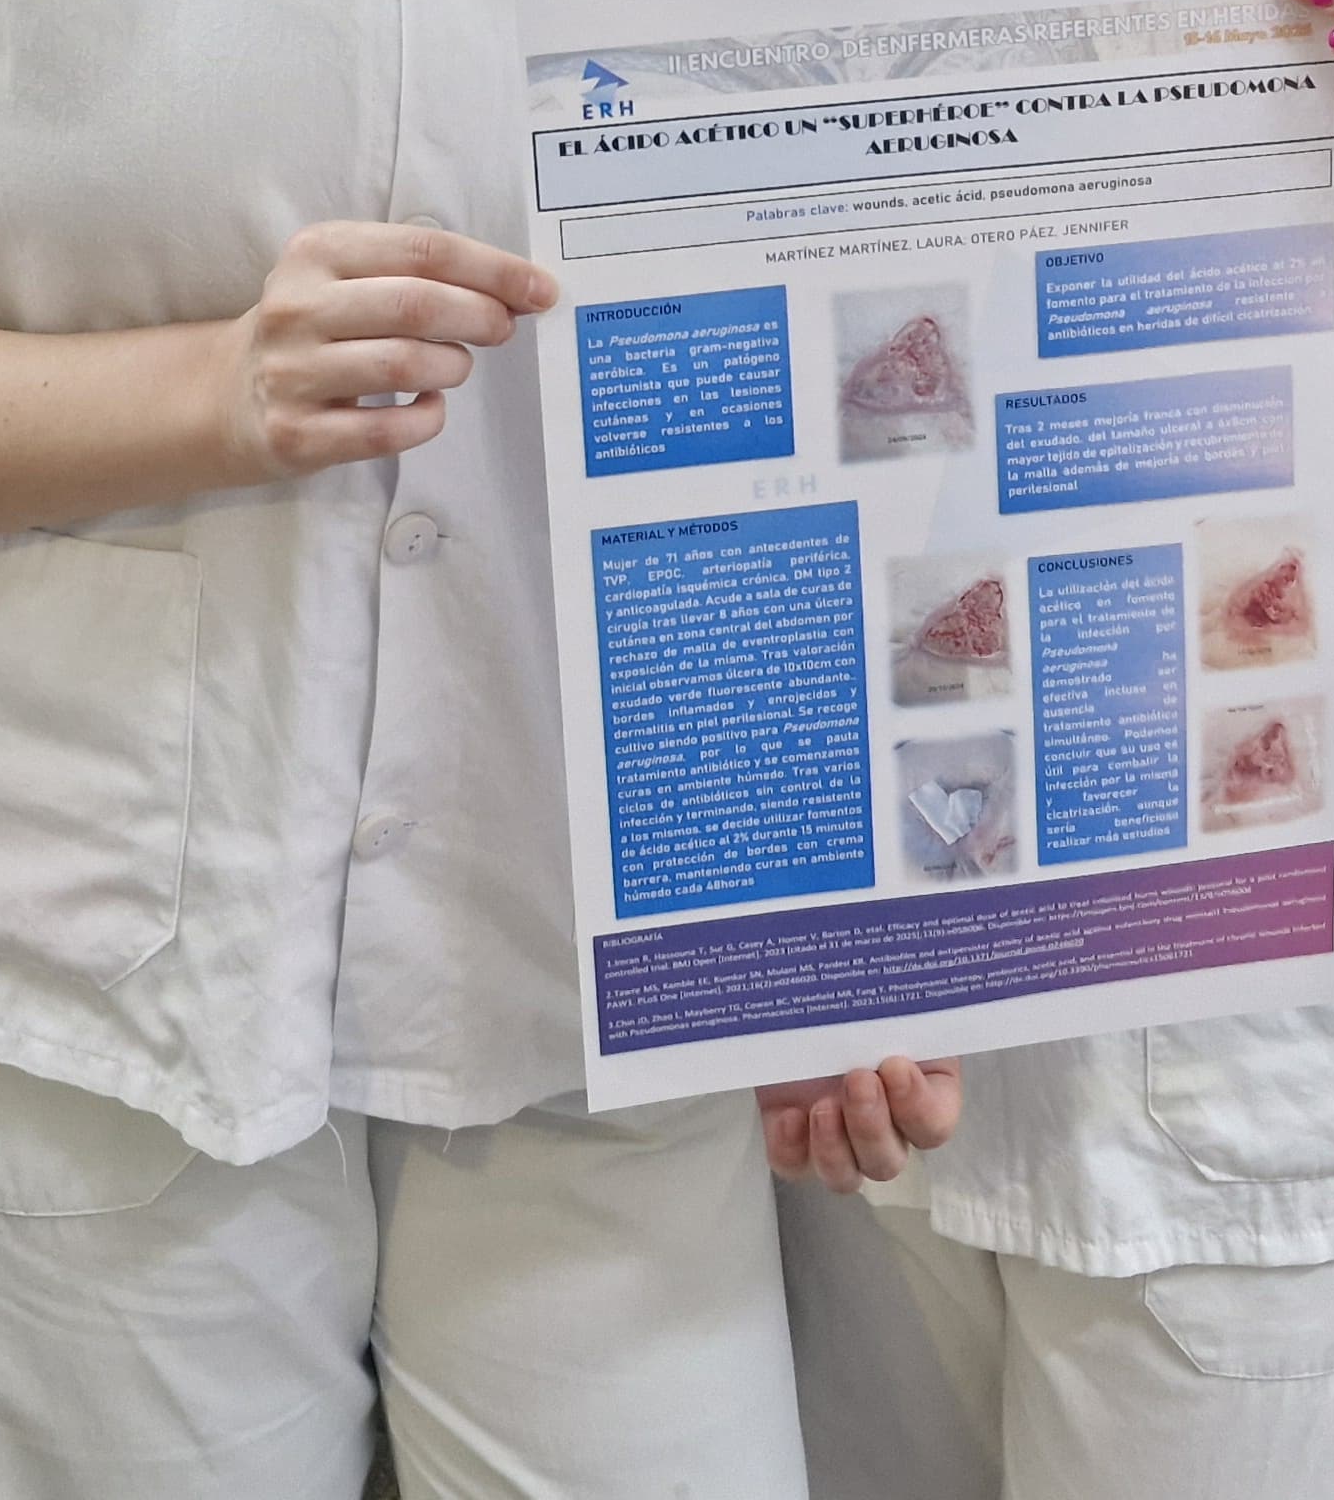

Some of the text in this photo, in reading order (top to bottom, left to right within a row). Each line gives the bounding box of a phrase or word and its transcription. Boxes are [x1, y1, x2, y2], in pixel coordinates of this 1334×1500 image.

[558, 139, 587, 156] EL
[592, 128, 669, 153] ÁCIDO
[674, 118, 779, 146] ACÉTICO
[785, 118, 817, 135] UN
[1015, 91, 1111, 115] CONTRA
[1117, 88, 1148, 106] LA
[1153, 73, 1316, 102] PSEUDOMONA
[582, 99, 634, 120] ERH
[866, 128, 1018, 155] AERUGINOSA
[747, 177, 1152, 222] Palabras clave: wounds, acetic ácid, pseudomona aeruginosa
[765, 246, 835, 264] MARTÍNEZ
[971, 230, 1015, 244] OTERO
[1063, 219, 1128, 236] JENNIFER
[1046, 252, 1104, 268] OBJETIVO
[587, 302, 681, 323] INTRODUCCIÓN
[587, 321, 778, 349] La Pseudomona aeruginosa es
[589, 337, 779, 365] una bacteria gram-negativa
[662, 362, 677, 373] Es
[693, 361, 708, 370] un
[724, 353, 780, 369] patógeno
[591, 369, 780, 398] oportunista que puede causar
[592, 384, 782, 412] infecciones en las lesiones
[1006, 392, 1087, 409] RESULTADOS
[593, 400, 782, 428] cutáneas y en ocasiones
[594, 415, 783, 443] volverse resistentes a los
[595, 443, 666, 459] antibióticos
[1008, 480, 1078, 499] perilesional
[602, 520, 738, 546] MATERIAL Y MÉTODOS
[603, 533, 850, 572] Mujer de 71 años con antecedentes de
[1038, 555, 1133, 573] CONCLUSIONES
[702, 557, 772, 575] arteriopatía
[605, 584, 672, 603] cardiopatía
[676, 578, 737, 594] isquémica
[794, 568, 813, 580] DM
[818, 567, 840, 579] tipo
[844, 564, 851, 574] 2
[624, 877, 755, 902] húmedo cada 48horas
[603, 932, 663, 948] BIBLIOGRAFÍA
